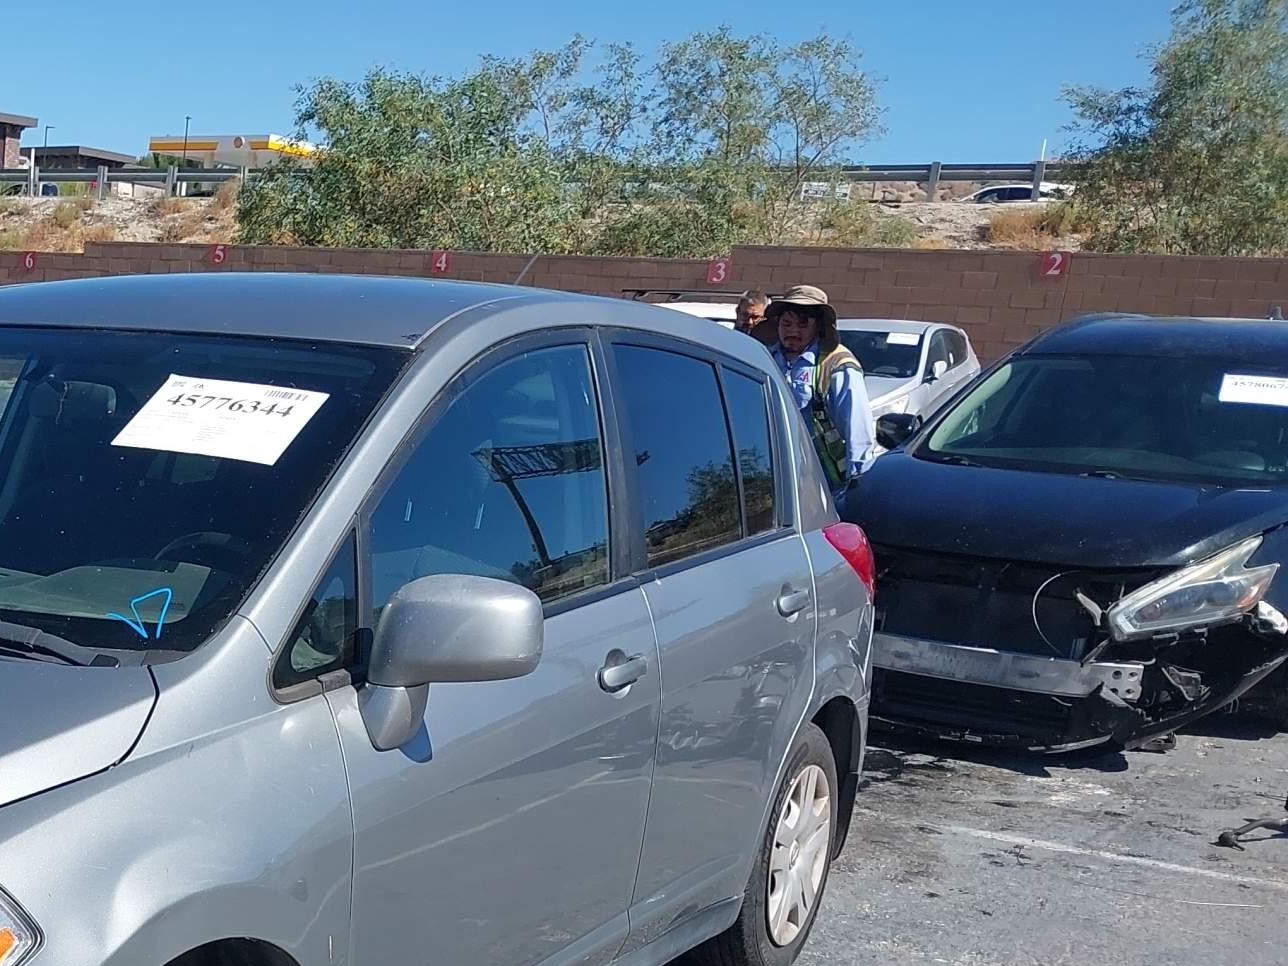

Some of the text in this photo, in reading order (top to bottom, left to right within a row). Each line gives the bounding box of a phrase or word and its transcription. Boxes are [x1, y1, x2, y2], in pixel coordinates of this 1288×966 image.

[25, 253, 34, 269] 6
[214, 245, 225, 263] 5
[435, 252, 448, 271] 4
[712, 262, 726, 282] 3
[1046, 253, 1063, 275] 2
[167, 392, 294, 417] 45776344
